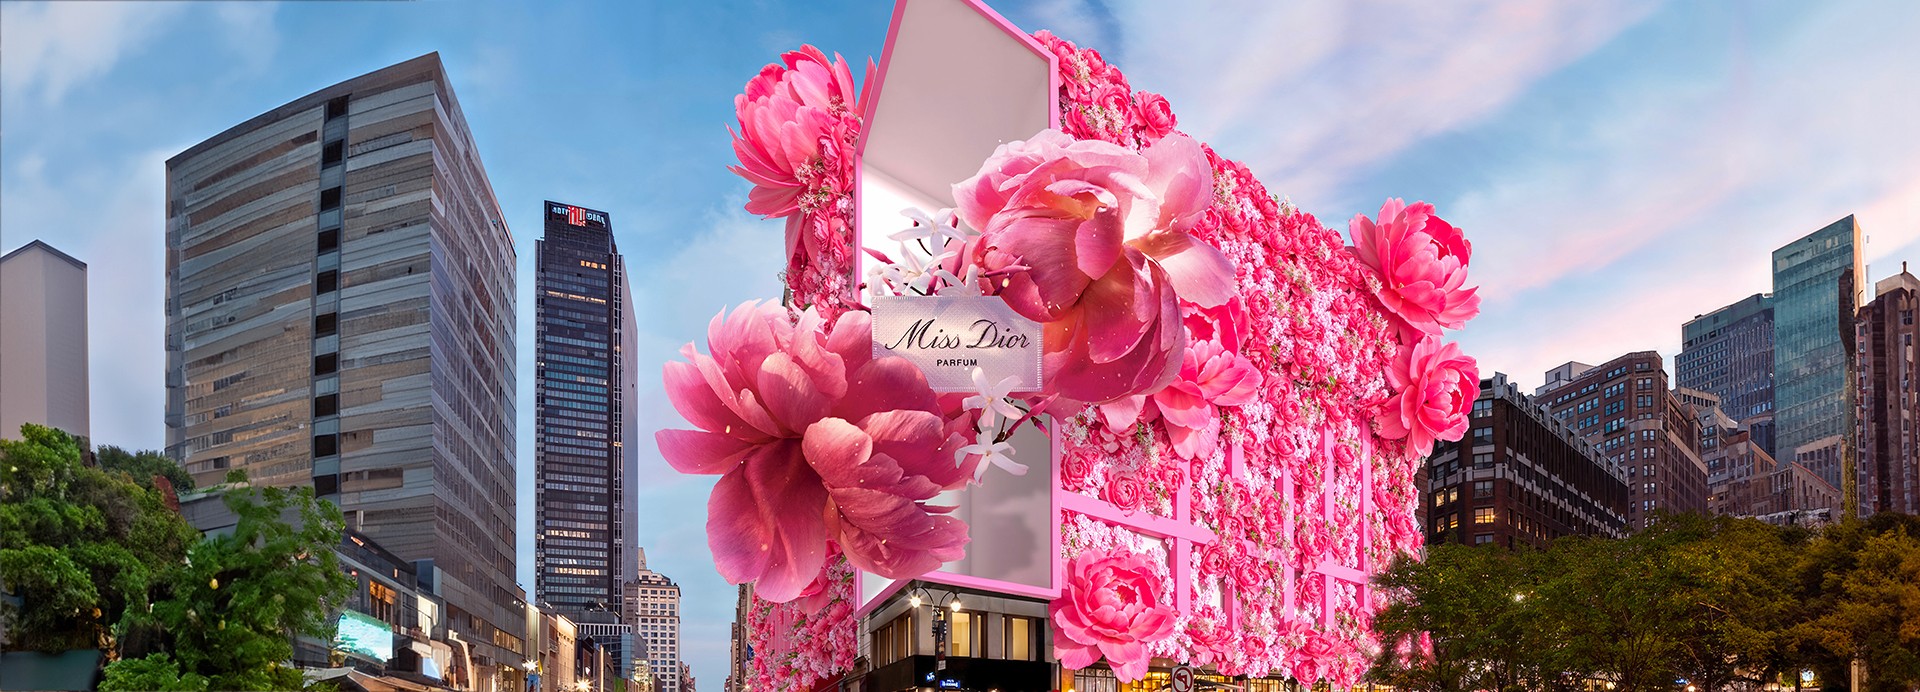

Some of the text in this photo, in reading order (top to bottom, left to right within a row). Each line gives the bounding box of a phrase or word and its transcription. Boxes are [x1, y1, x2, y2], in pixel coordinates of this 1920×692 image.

[885, 318, 1030, 350] Miss Dior
[936, 359, 978, 367] PARFUM
